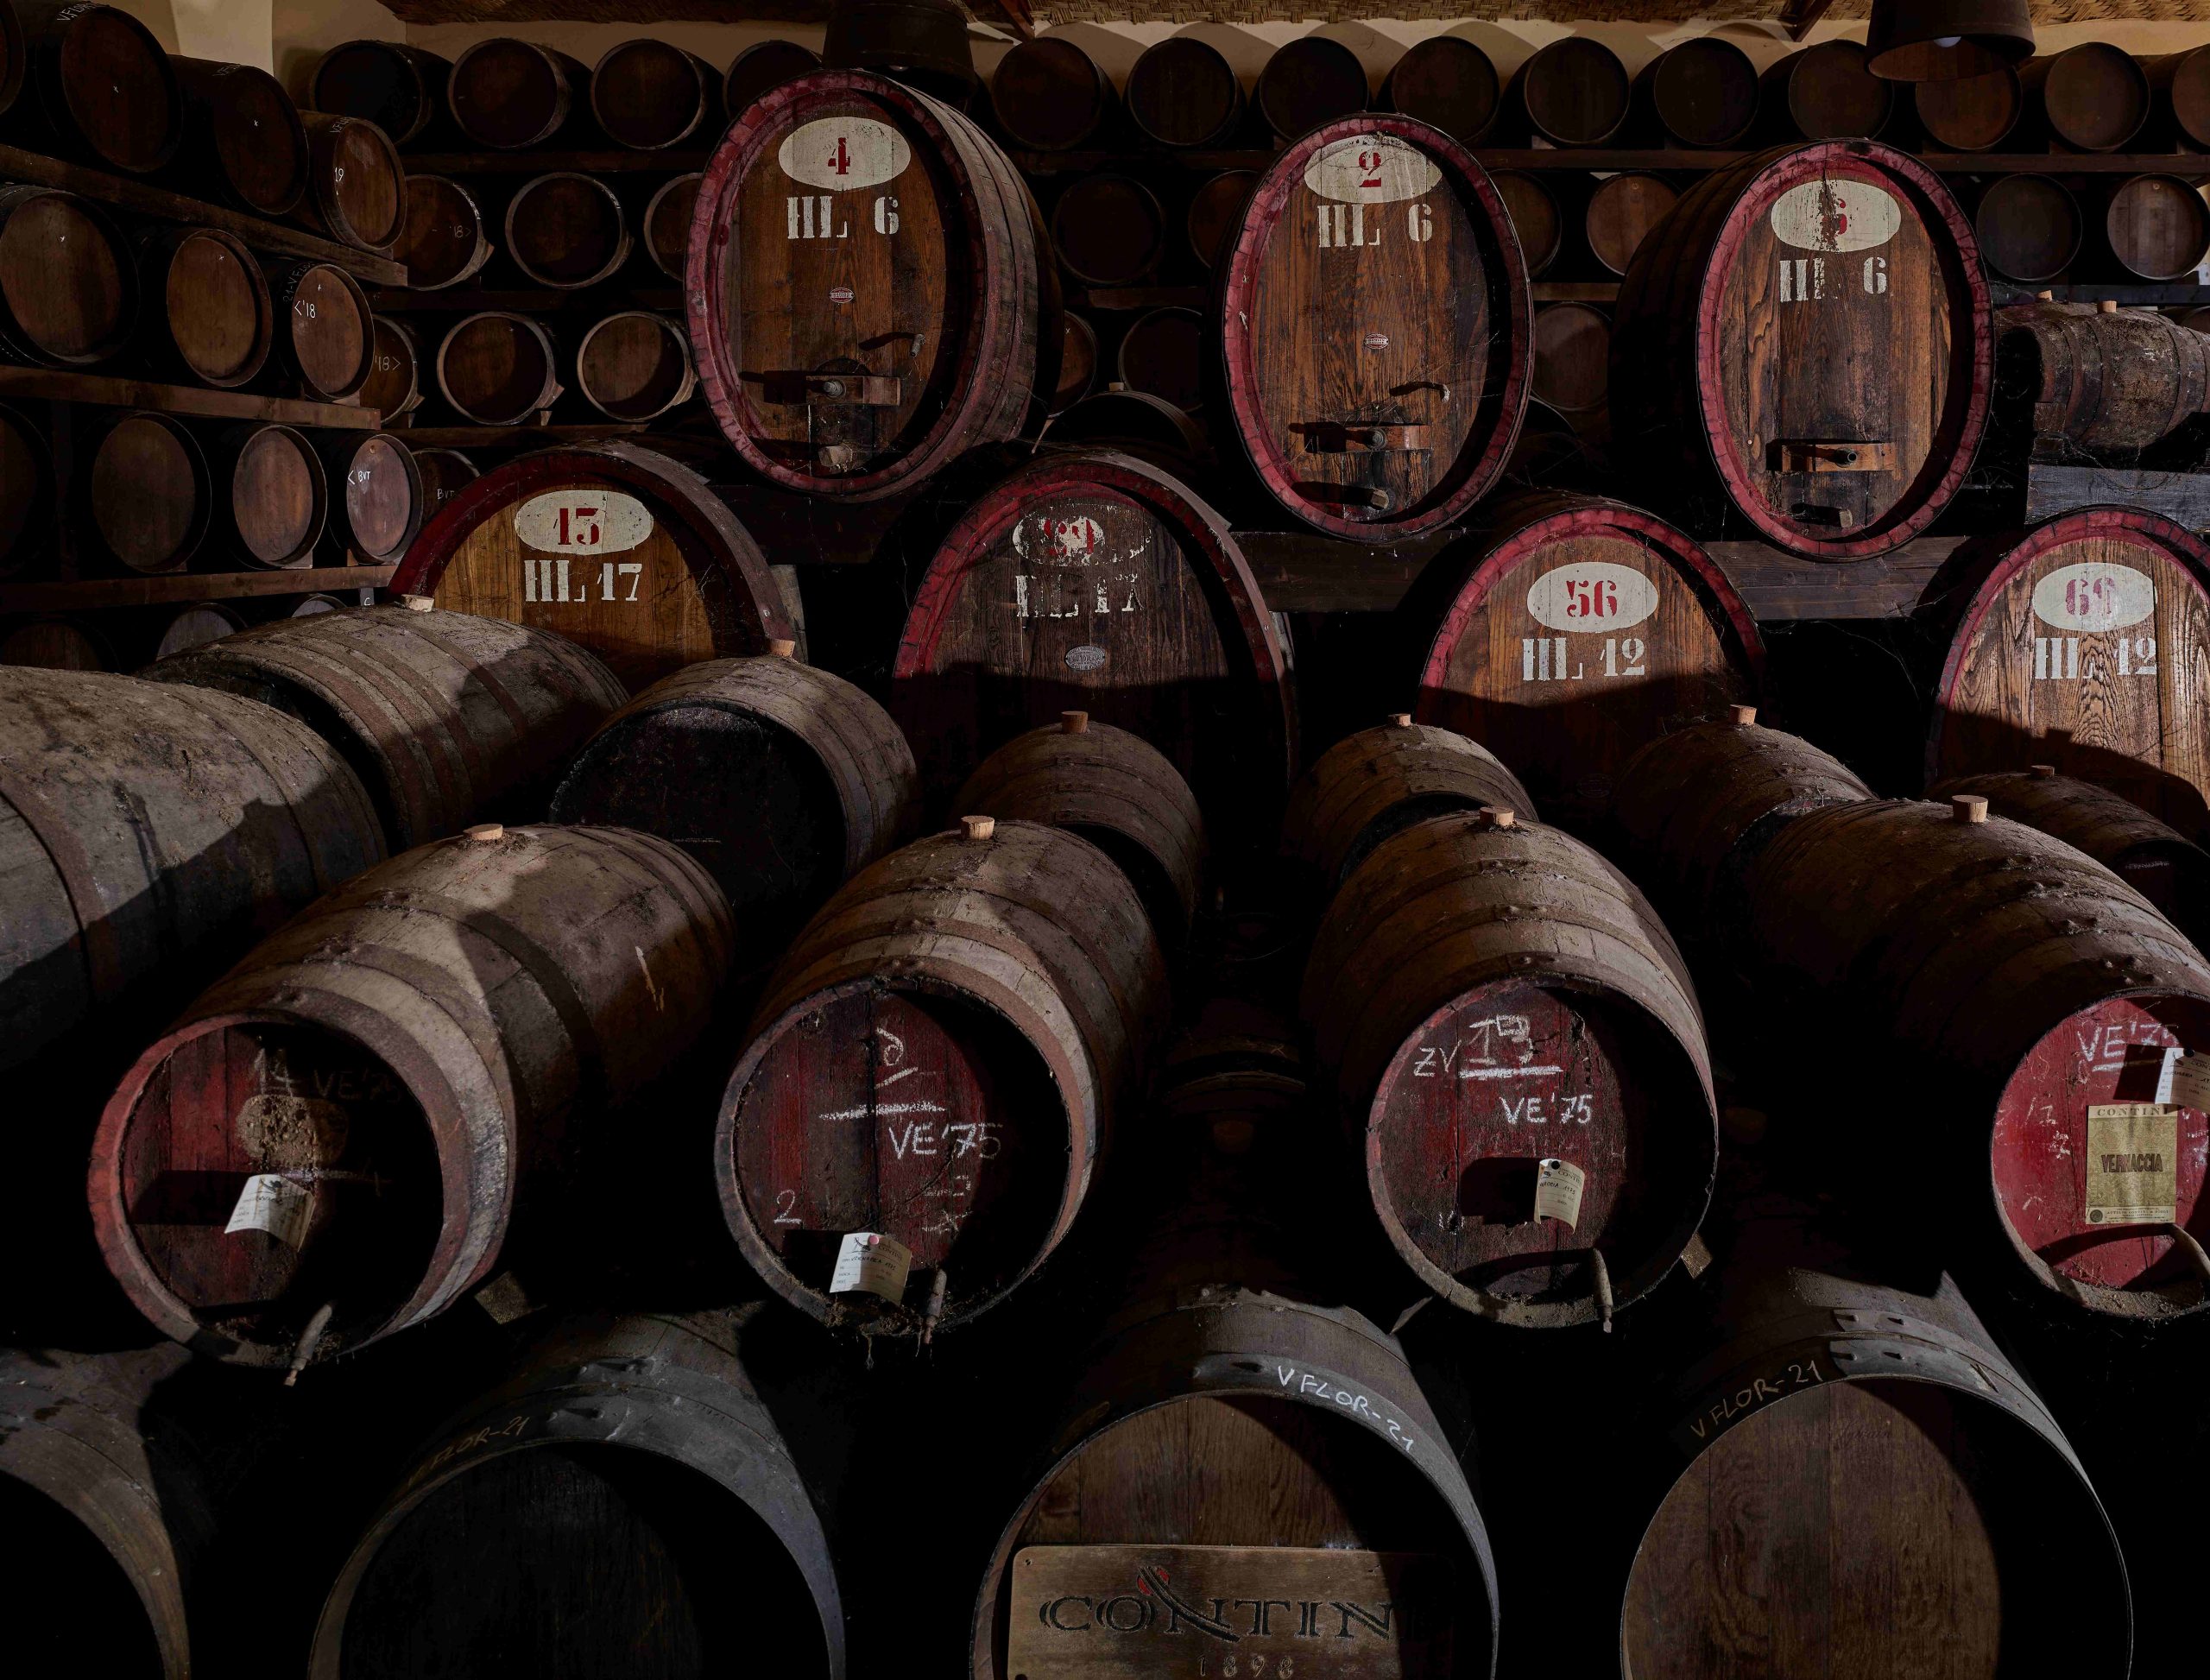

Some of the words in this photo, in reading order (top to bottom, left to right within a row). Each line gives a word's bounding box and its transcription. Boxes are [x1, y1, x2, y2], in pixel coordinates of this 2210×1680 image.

[334, 167, 344, 182] 19
[828, 137, 850, 174] 4
[1358, 150, 1382, 188] 2
[786, 196, 848, 239] HL
[875, 196, 900, 235] 6
[1317, 204, 1381, 249] HL
[1408, 203, 1434, 243] 6
[1863, 256, 1888, 295] 6
[524, 559, 586, 603] HL
[597, 562, 642, 602] 17
[1566, 579, 1619, 618] 56
[1522, 636, 1584, 682] HL
[1600, 637, 1646, 677] 12
[2115, 637, 2157, 675] 12
[1499, 1091, 1594, 1125] VE'75
[2101, 1153, 2164, 1173] VERNACCIA
[774, 1188, 803, 1225] 2
[1039, 1566, 1397, 1641] CONTIN
